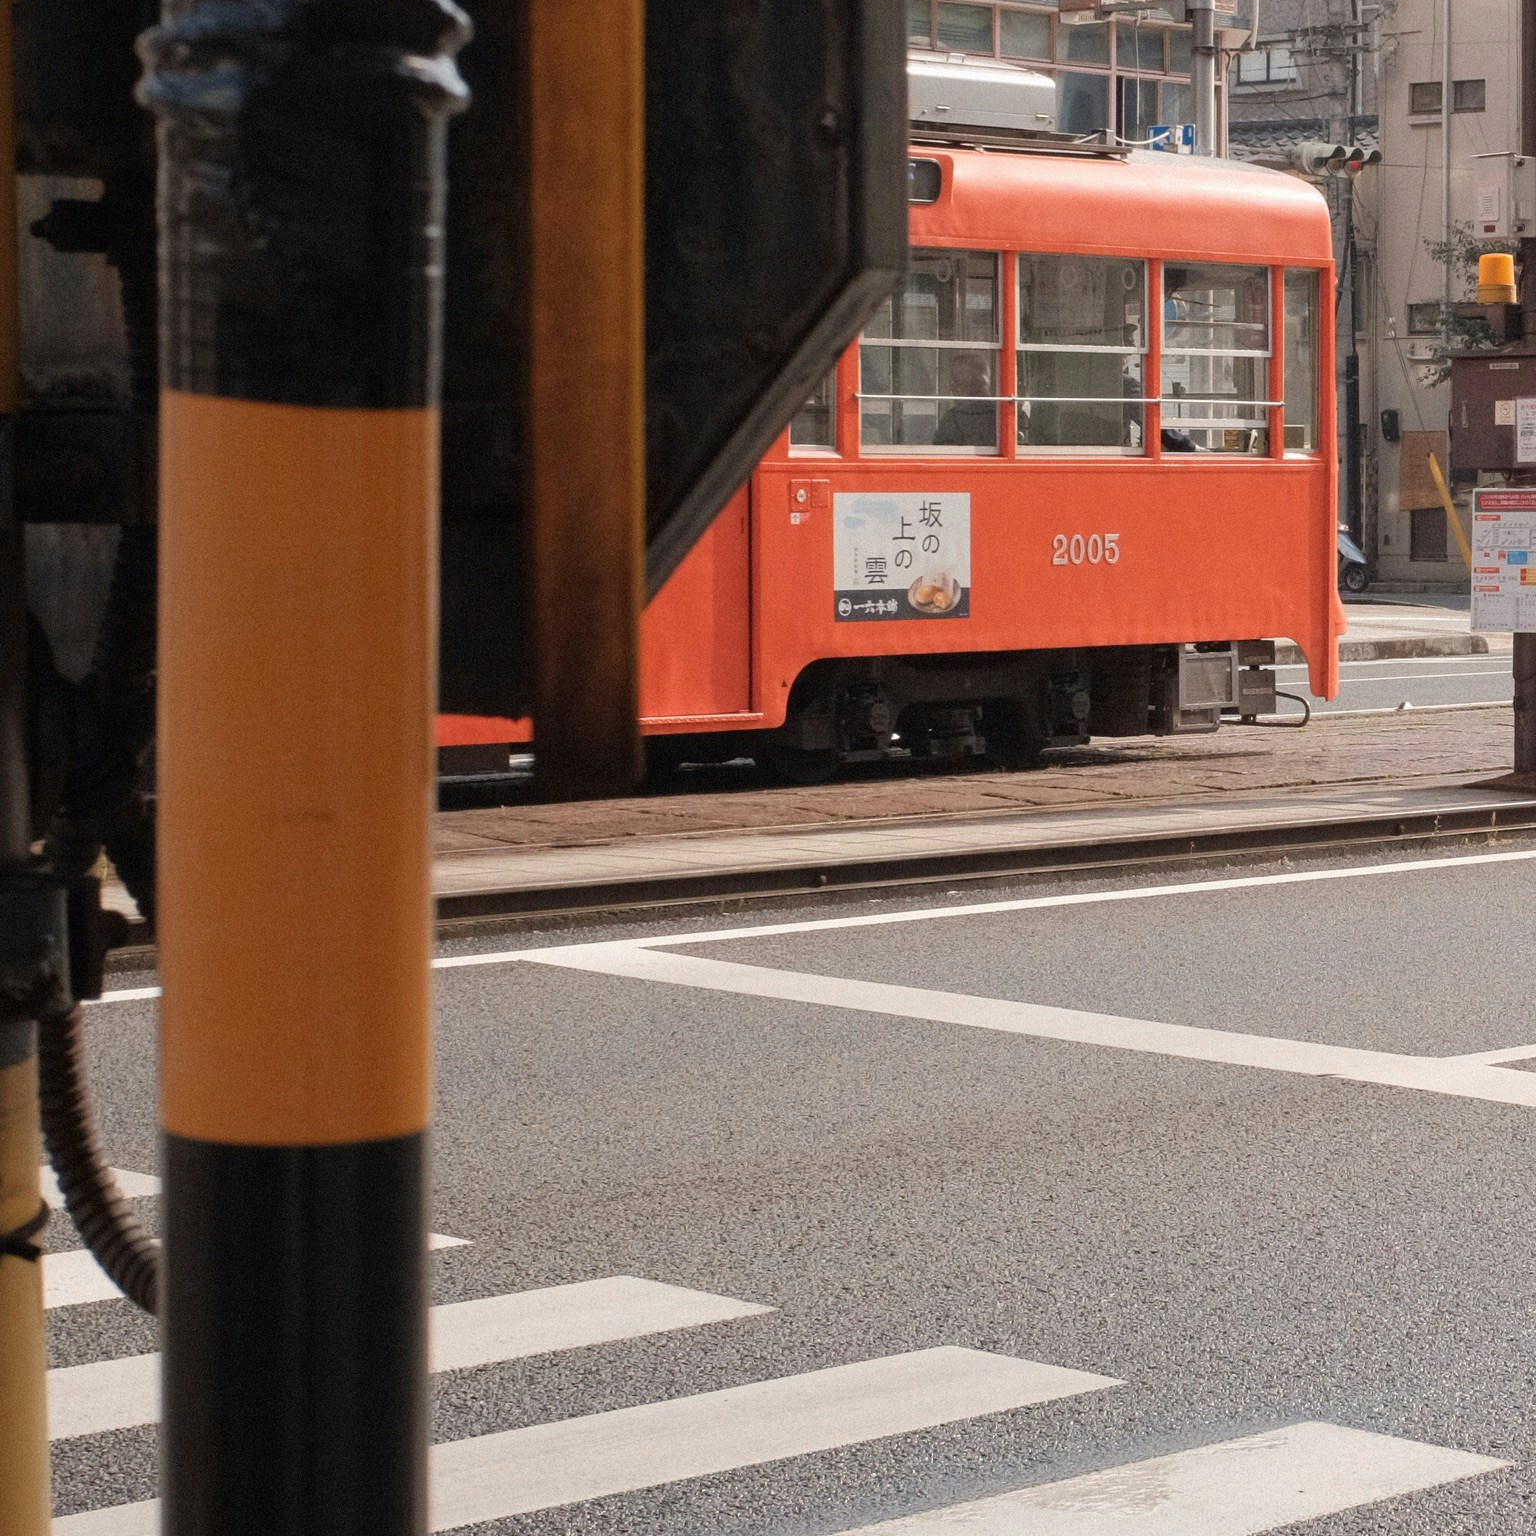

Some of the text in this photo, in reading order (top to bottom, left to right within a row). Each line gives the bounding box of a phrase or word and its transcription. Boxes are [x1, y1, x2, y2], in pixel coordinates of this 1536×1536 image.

[892, 516, 917, 569] 上の
[919, 500, 943, 554] 坂の
[1051, 533, 1120, 565] 2005
[864, 557, 889, 584] 雲
